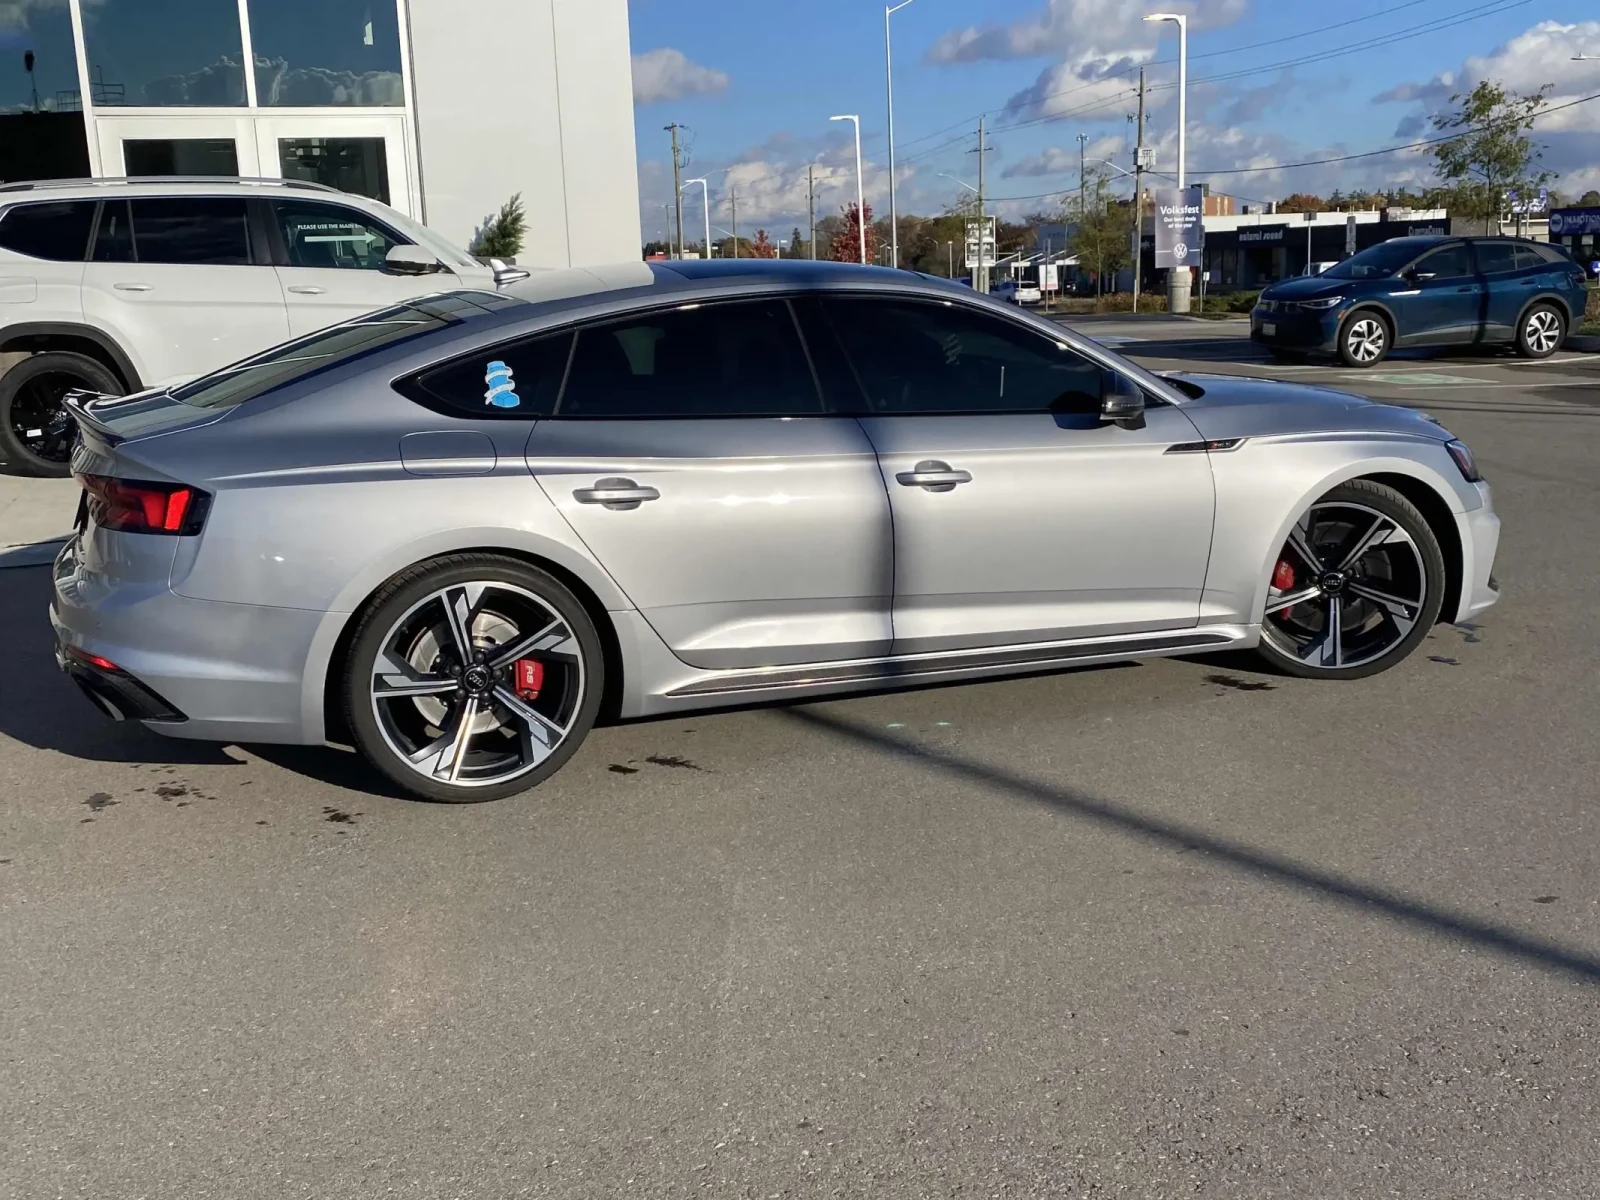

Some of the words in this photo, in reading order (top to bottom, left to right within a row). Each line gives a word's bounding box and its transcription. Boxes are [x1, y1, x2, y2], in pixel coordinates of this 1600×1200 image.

[1160, 205, 1199, 214] Volksfest
[1239, 231, 1262, 241] natural
[1263, 229, 1283, 240] sound
[526, 665, 534, 684] RS
